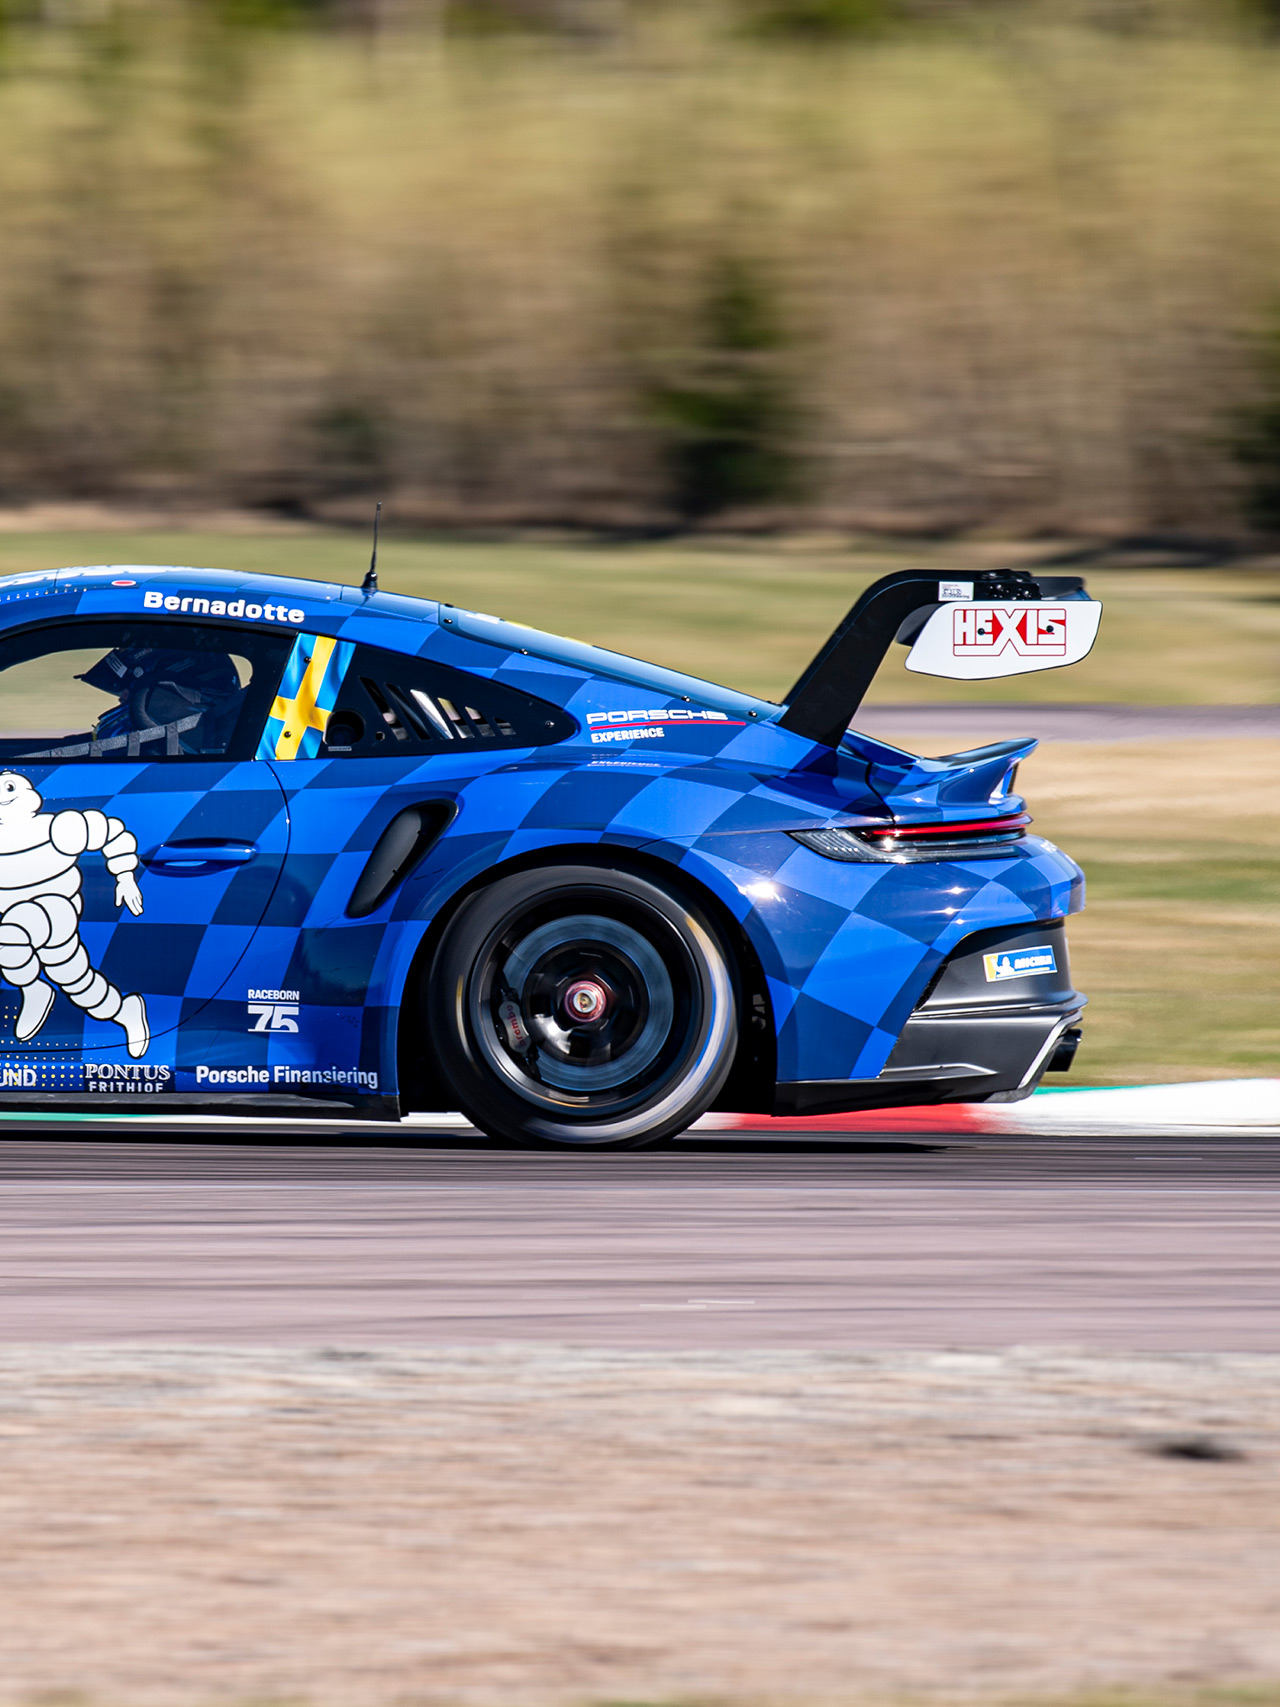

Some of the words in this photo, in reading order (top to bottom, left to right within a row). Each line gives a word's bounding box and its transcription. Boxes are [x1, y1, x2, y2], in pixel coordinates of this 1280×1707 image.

[143, 591, 305, 623] Bernadotte
[953, 608, 1067, 656] HEXIS
[586, 709, 729, 725] PORSCHE
[591, 727, 665, 744] EXPERIENCE
[247, 989, 300, 1001] RACEBORN
[247, 1004, 300, 1033] 75
[84, 1063, 171, 1081] PONTUS
[195, 1065, 270, 1083] Porsche
[273, 1065, 379, 1089] Finansiering
[88, 1081, 164, 1092] FRITHIOF
